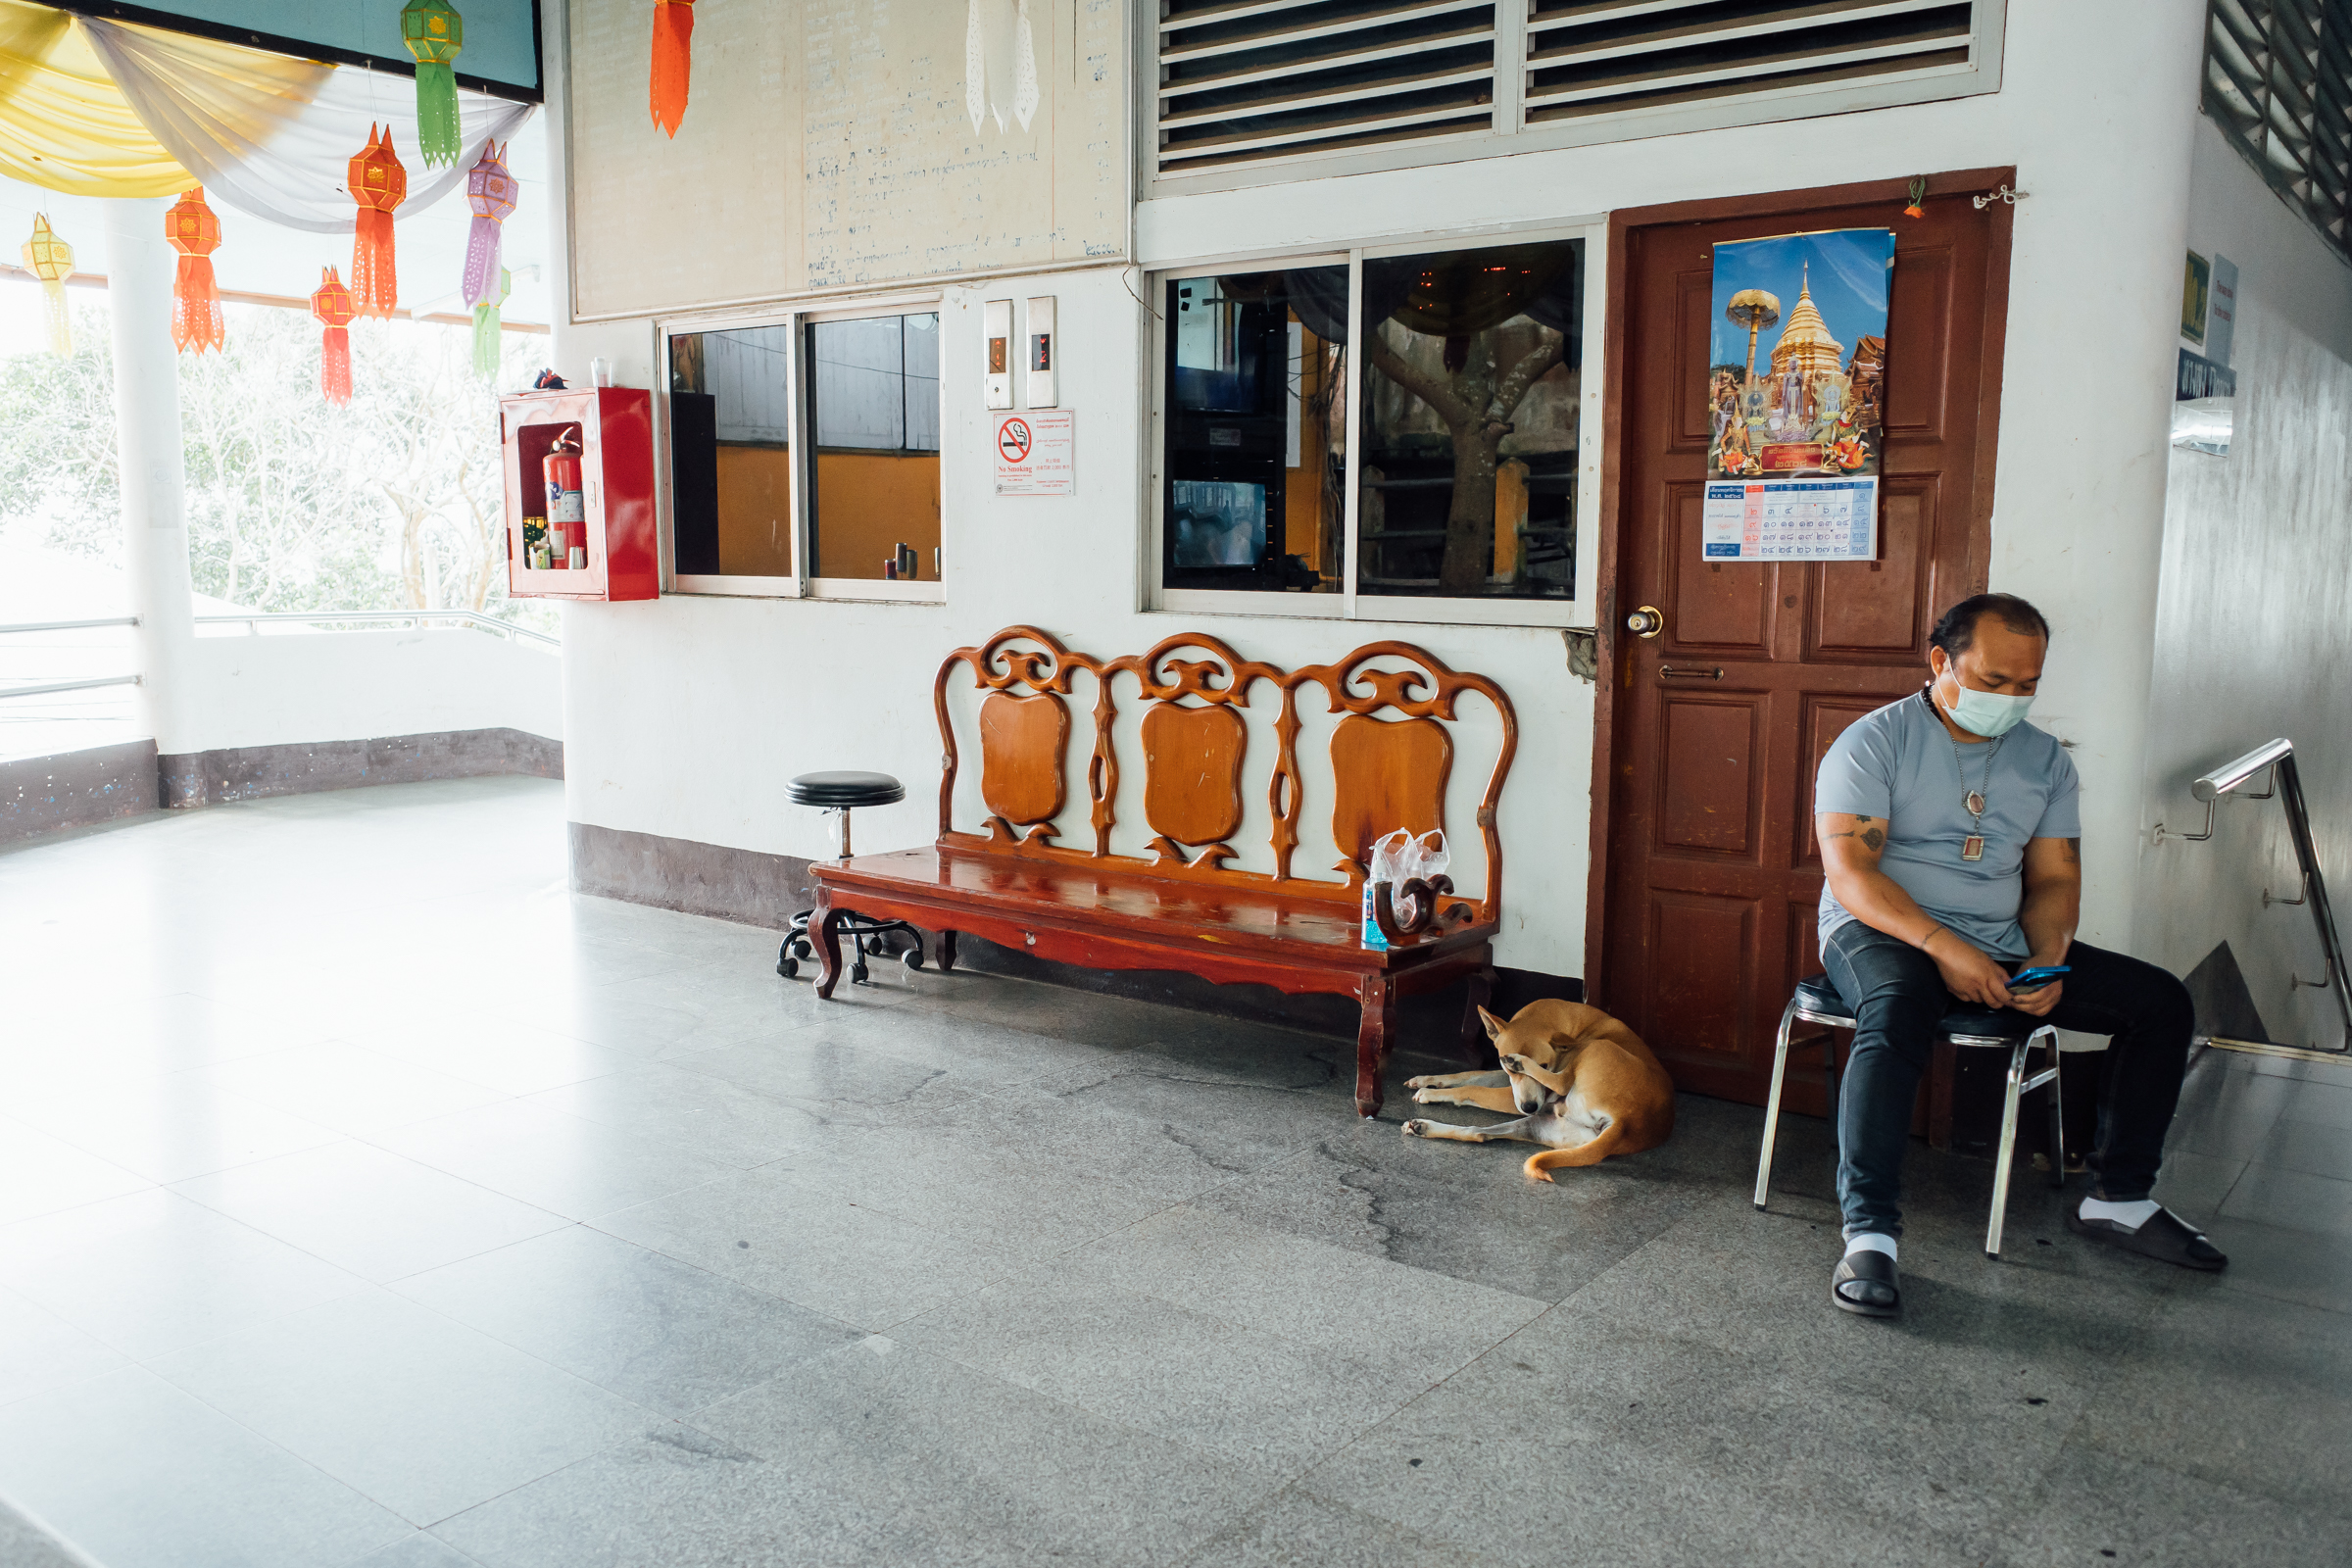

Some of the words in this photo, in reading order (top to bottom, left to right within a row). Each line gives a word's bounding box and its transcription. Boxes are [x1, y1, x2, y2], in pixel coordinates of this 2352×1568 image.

[1039, 350, 1047, 363] 2
[1775, 460, 1807, 468] ๒๕๖๘
[1007, 465, 1032, 473] Smoking
